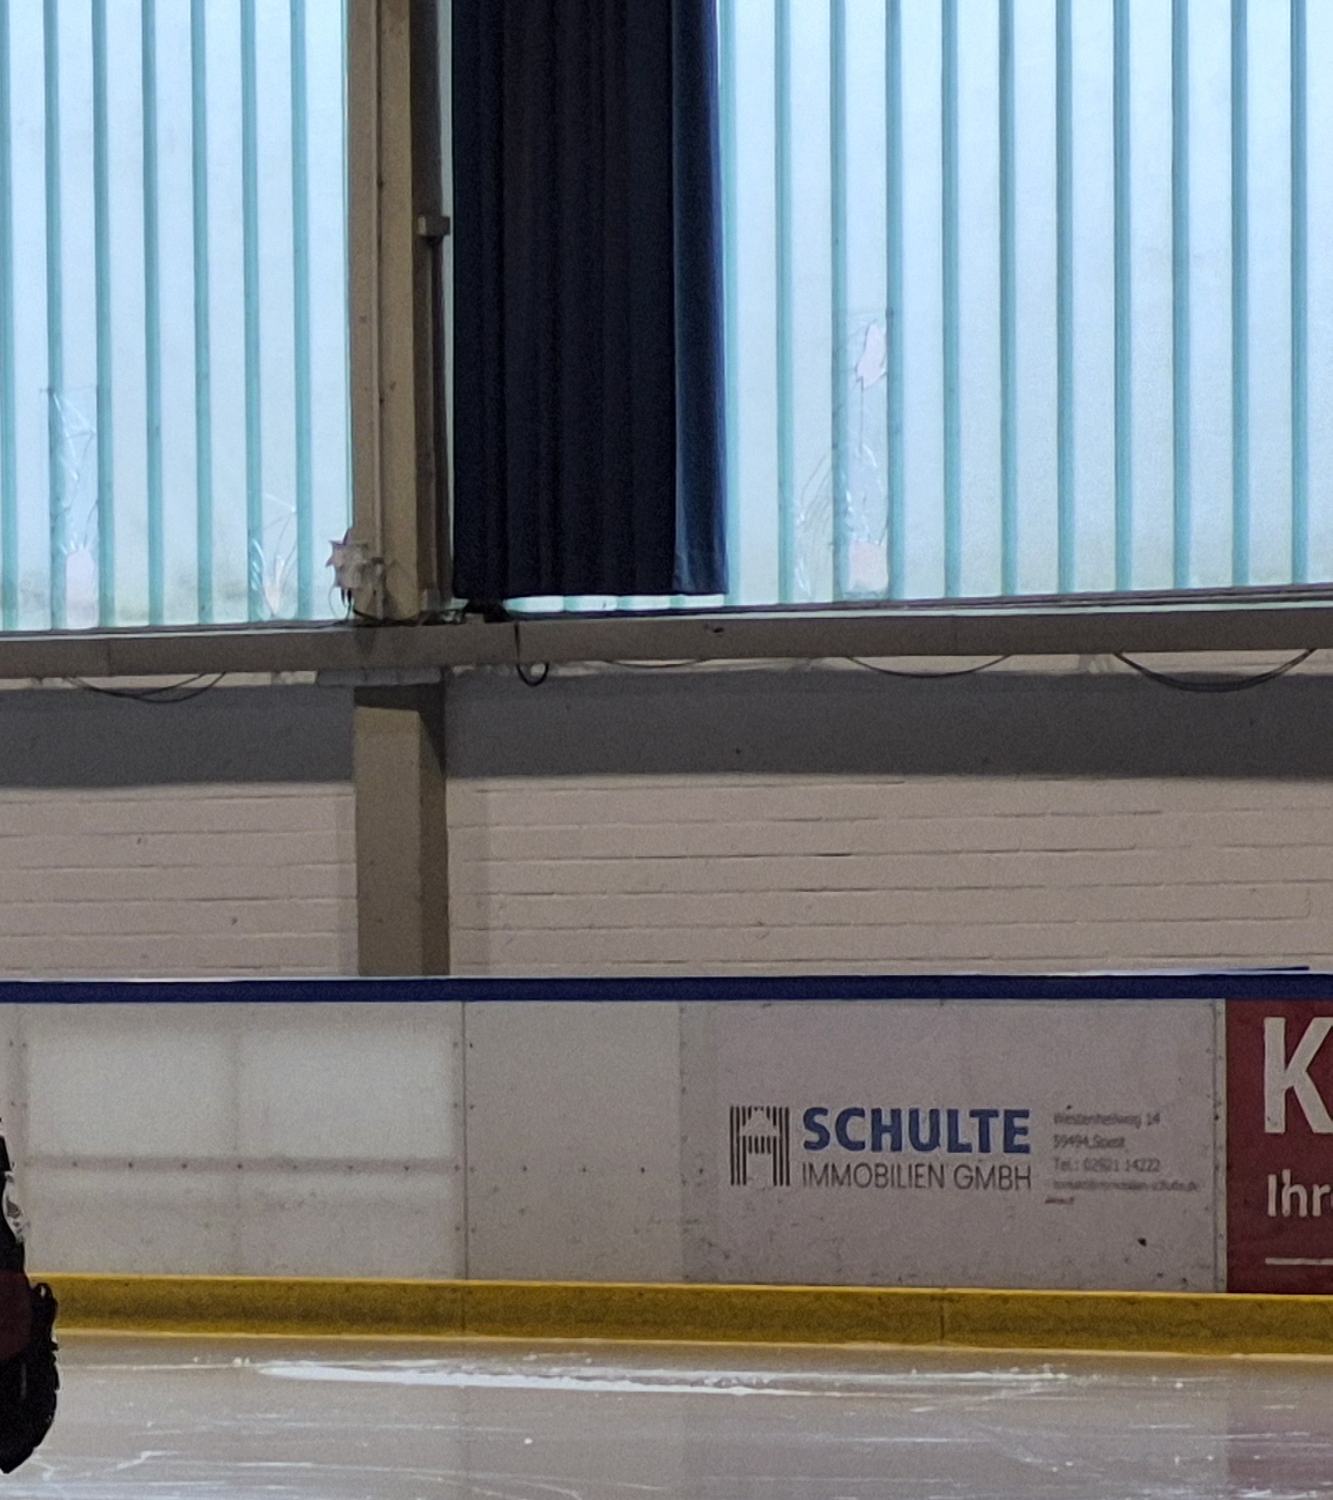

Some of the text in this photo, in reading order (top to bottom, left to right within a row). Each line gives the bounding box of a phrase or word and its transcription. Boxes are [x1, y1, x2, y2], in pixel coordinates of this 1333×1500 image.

[802, 1106, 1031, 1154] SCHULTE
[802, 1162, 945, 1189] IMMOBILIEN
[953, 1163, 1032, 1190] GMBH
[1267, 1169, 1333, 1217] Ihr
